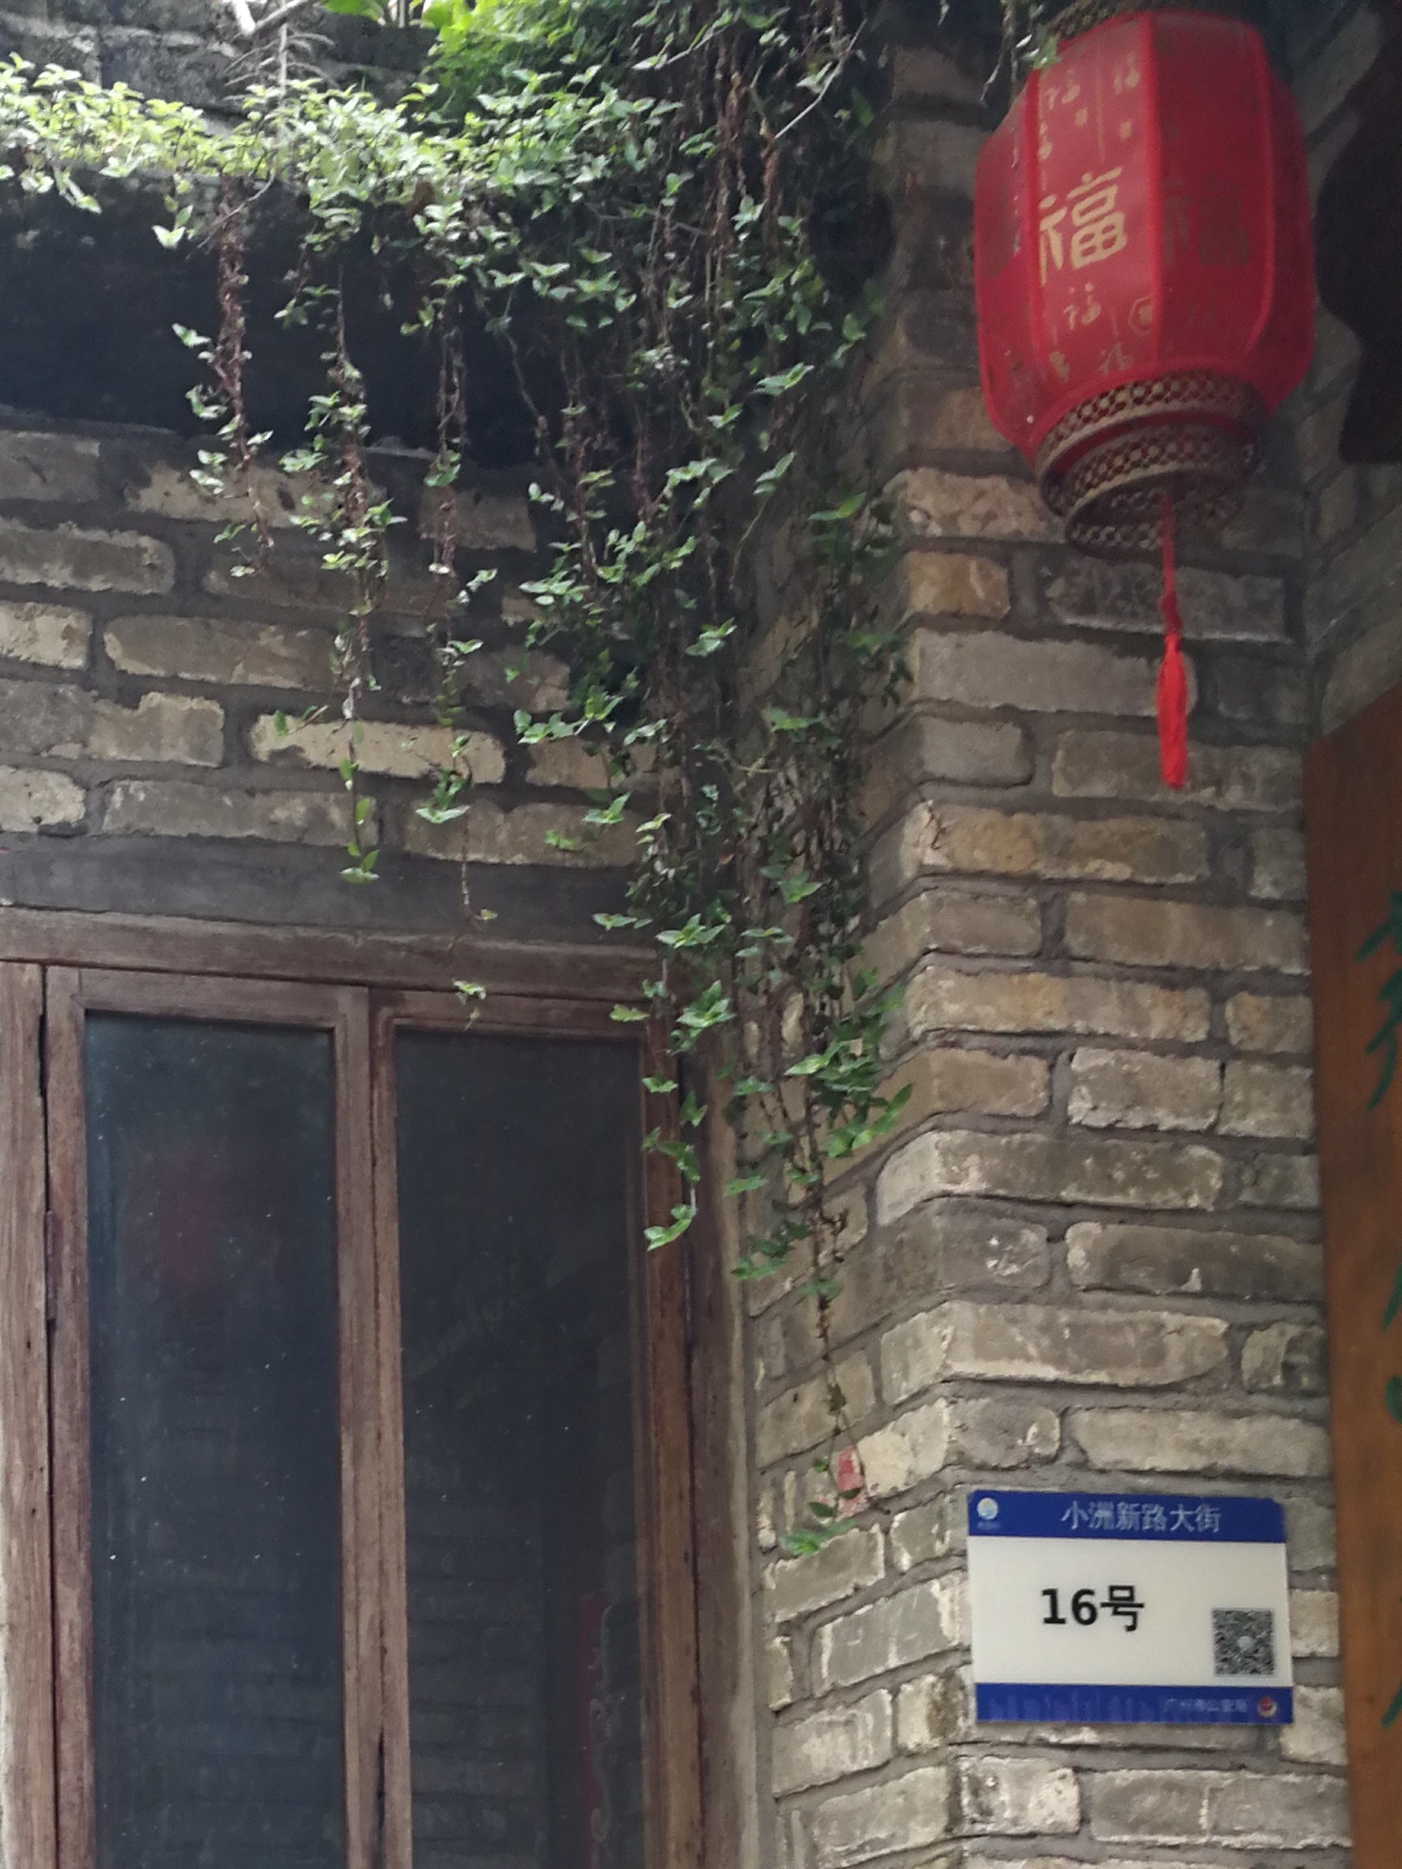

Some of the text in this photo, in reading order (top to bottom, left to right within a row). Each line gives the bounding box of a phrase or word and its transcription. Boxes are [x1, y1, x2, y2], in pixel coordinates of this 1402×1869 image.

[1039, 166, 1128, 287] 福
[1060, 1499, 1222, 1533] 小洲新路大街
[1041, 1584, 1145, 1632] 16号
